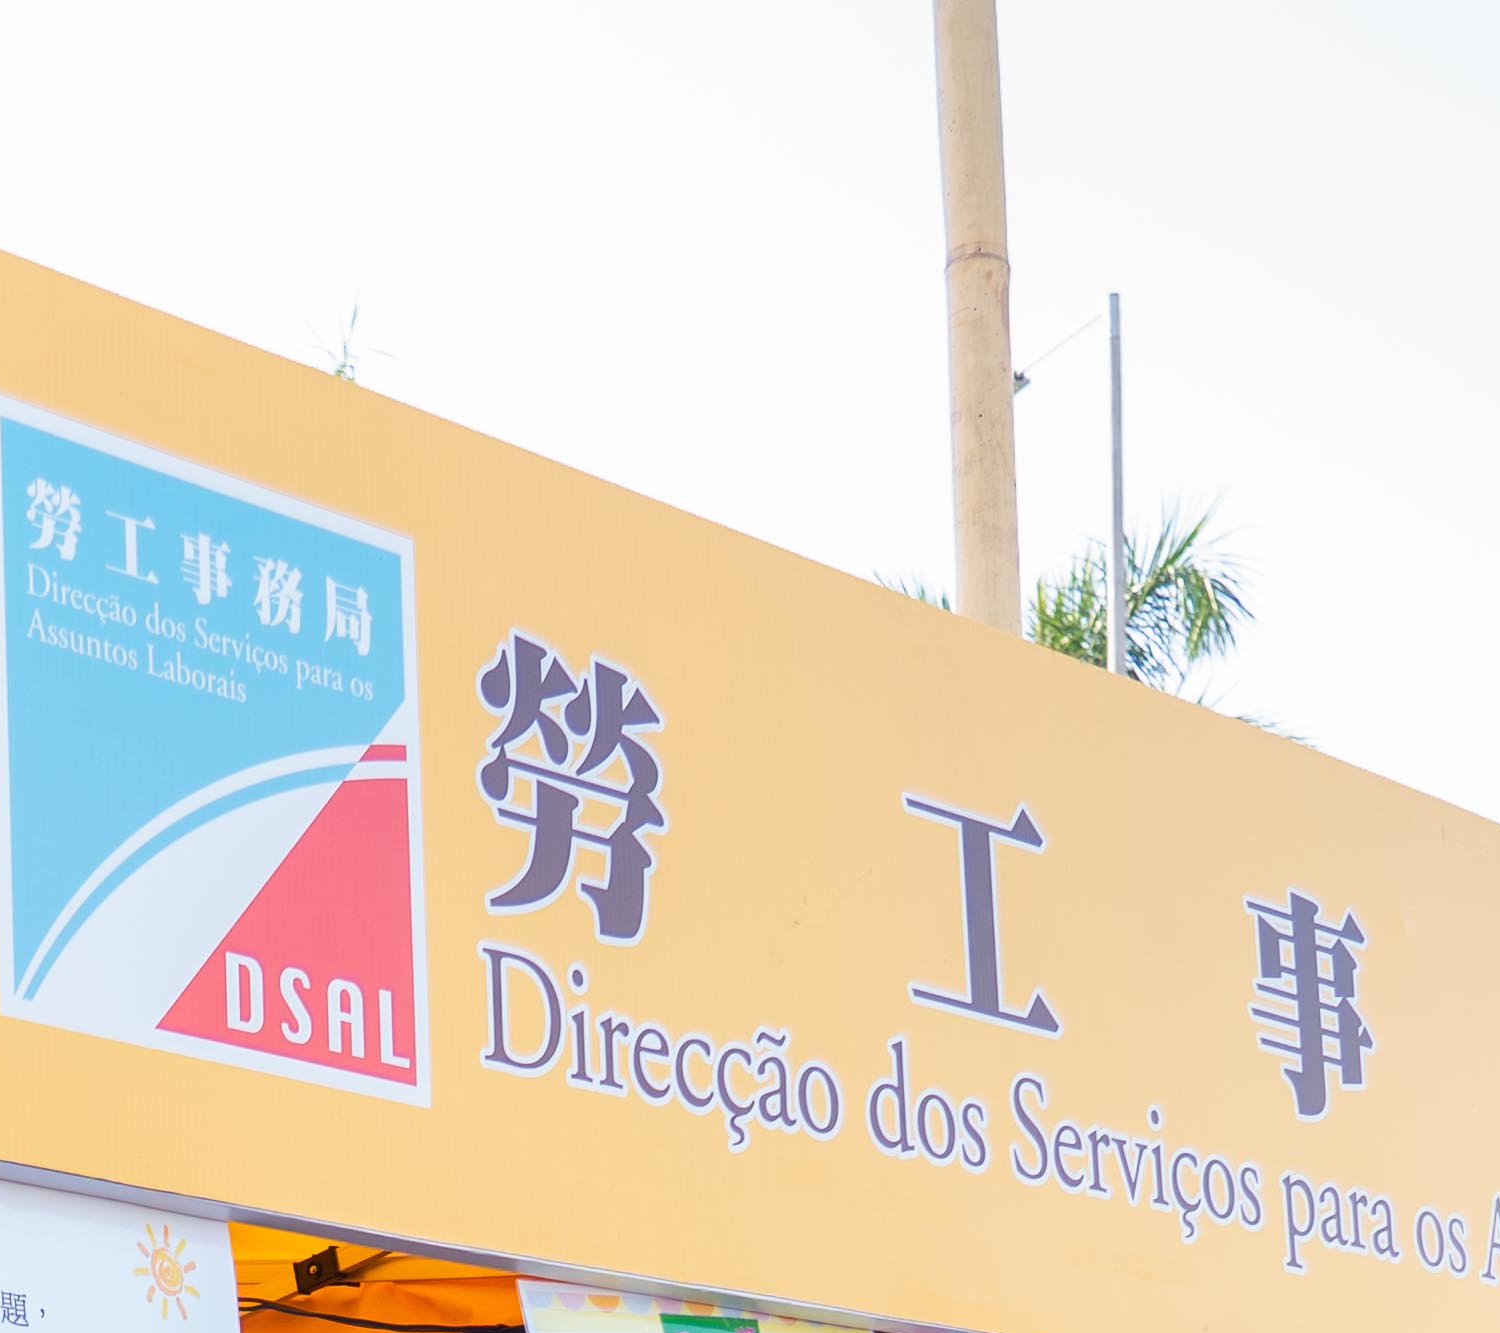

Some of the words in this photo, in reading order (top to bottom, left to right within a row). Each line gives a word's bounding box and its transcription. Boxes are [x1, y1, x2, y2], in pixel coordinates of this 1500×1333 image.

[25, 477, 373, 656] 勞工事務局
[26, 563, 137, 628] Direcção
[145, 600, 187, 642] dos
[195, 619, 289, 675] Serviços
[296, 655, 345, 696] para
[351, 675, 374, 700] os
[26, 609, 138, 671] Assuntos
[147, 646, 247, 703] Laborais
[225, 951, 411, 1069] DSAL
[482, 946, 840, 1147] Direcção
[869, 1041, 987, 1168] dos
[1013, 1076, 1262, 1239] Serviços
[1284, 1173, 1399, 1269] para
[1416, 1211, 1467, 1273] os
